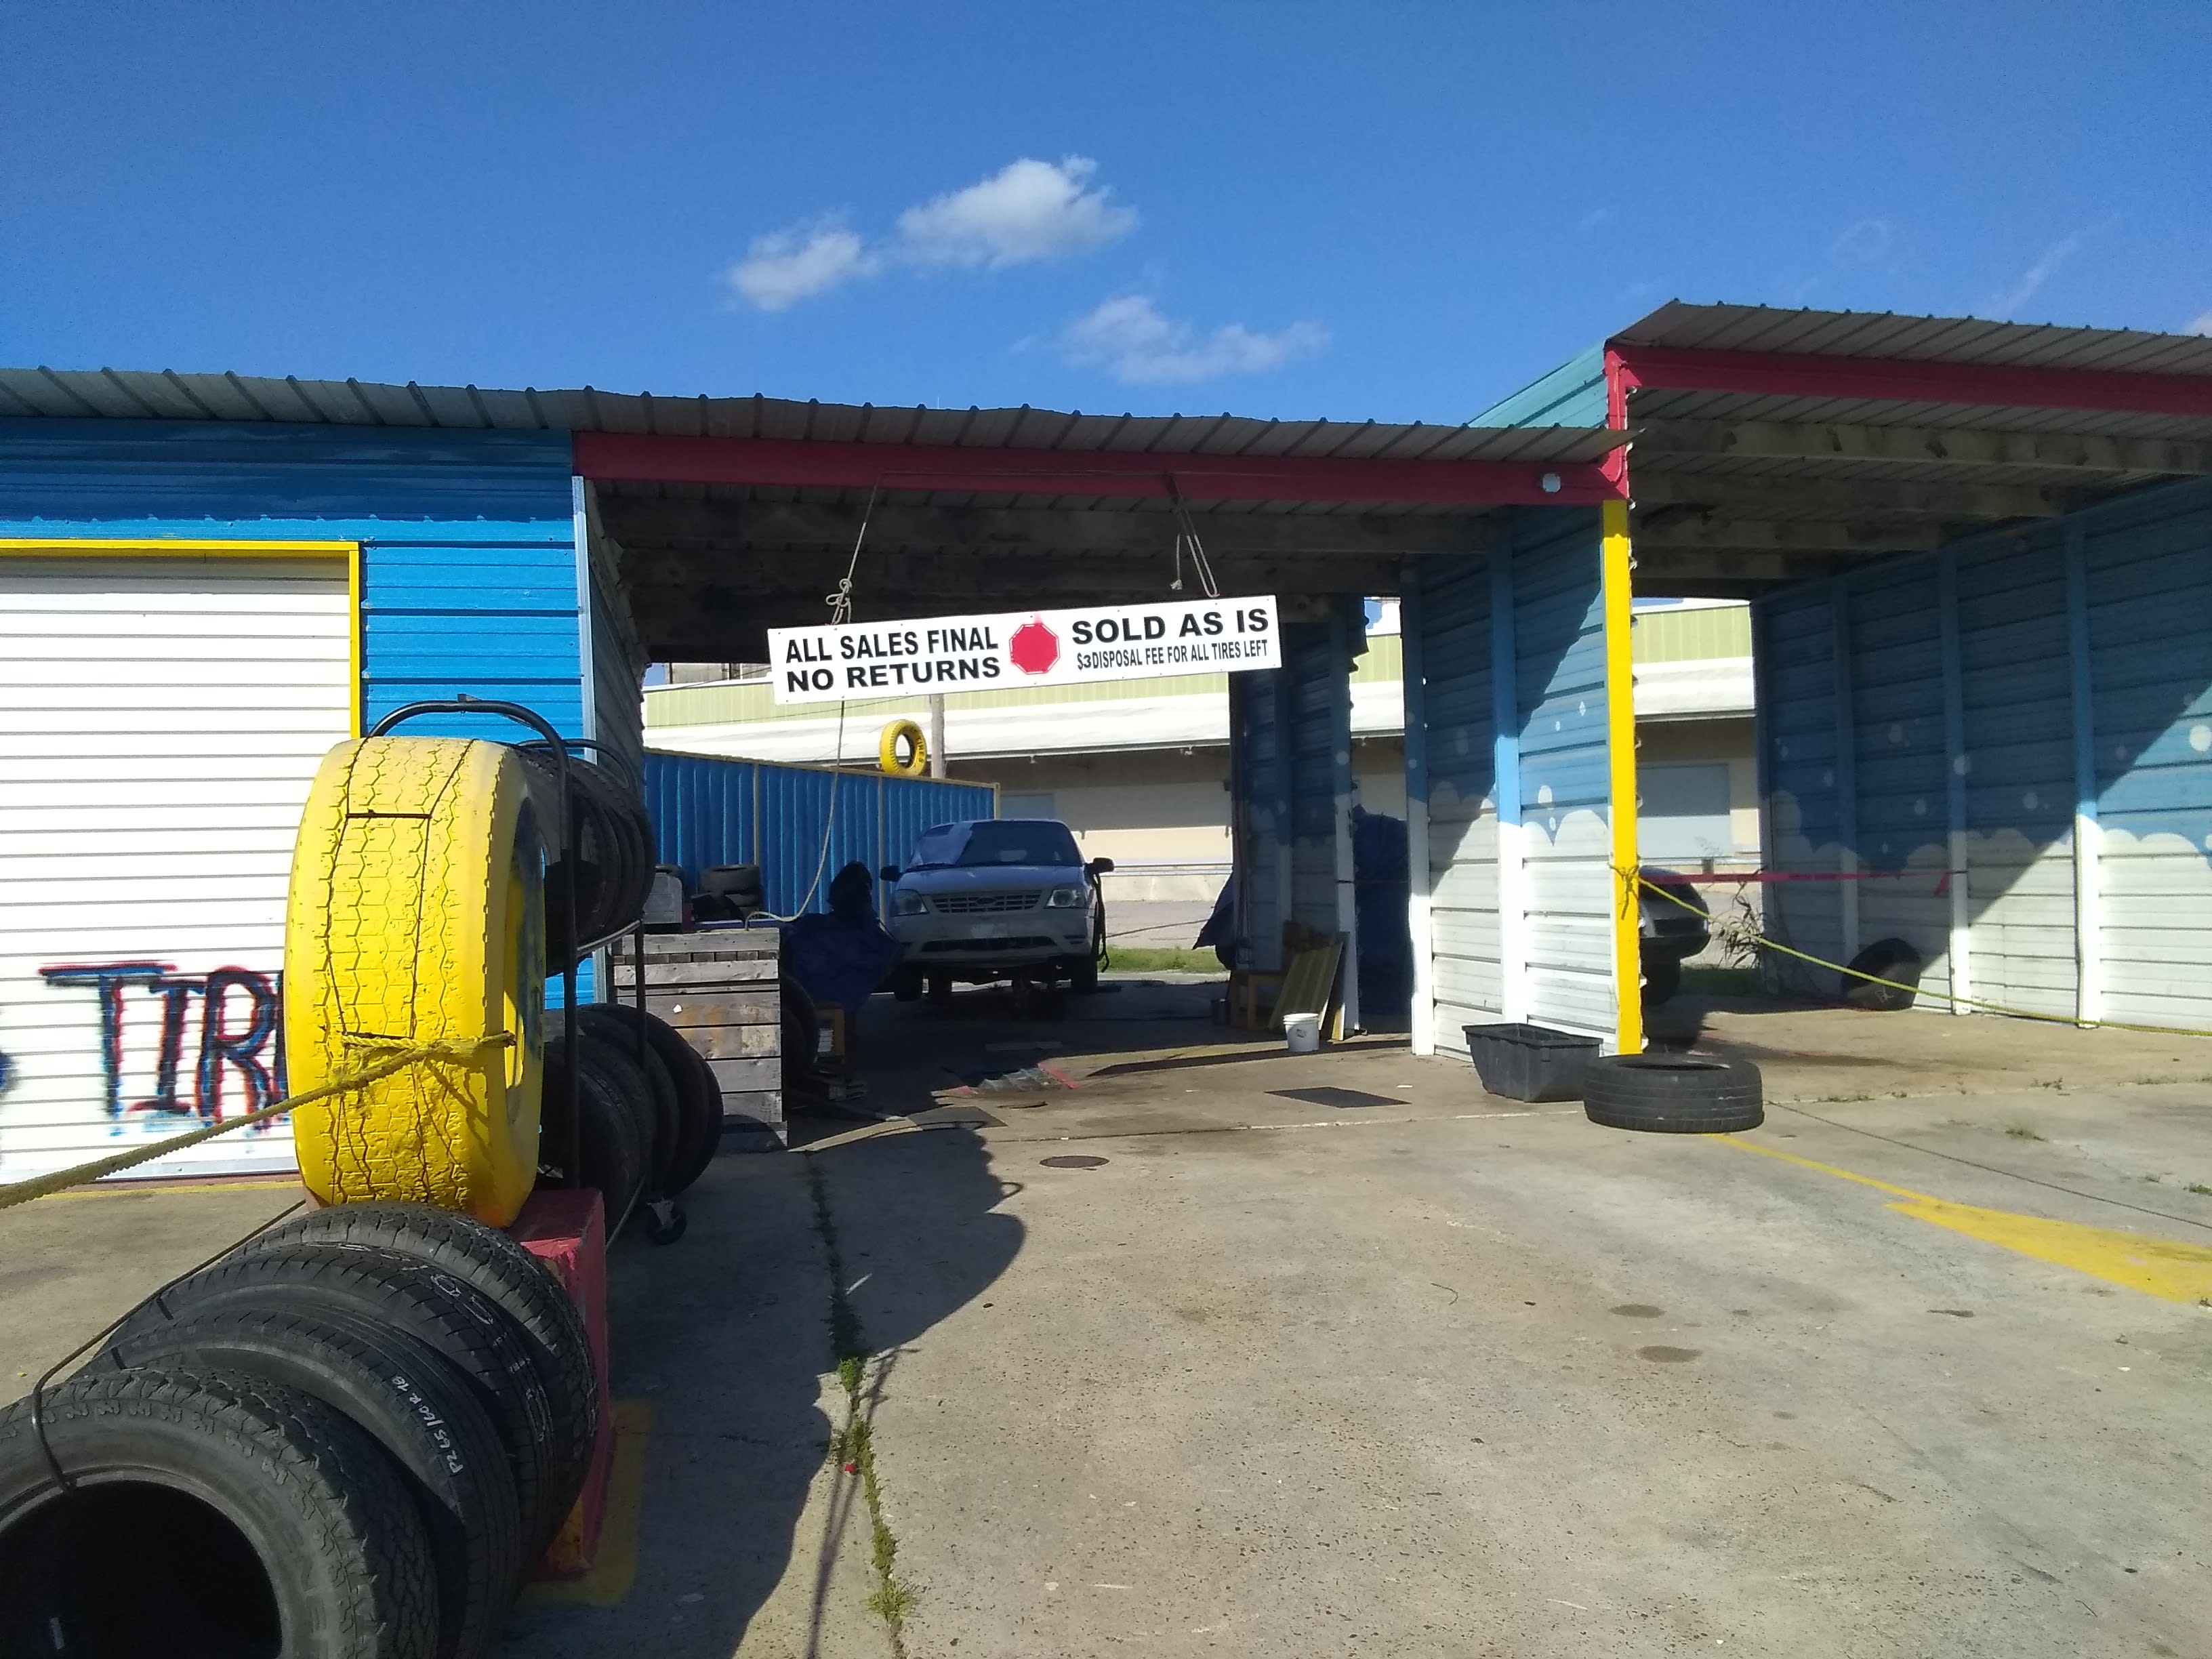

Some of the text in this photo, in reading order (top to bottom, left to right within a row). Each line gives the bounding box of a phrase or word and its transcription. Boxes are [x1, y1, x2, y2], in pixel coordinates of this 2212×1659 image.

[1071, 608, 1269, 644] SOLD AS IS
[785, 626, 999, 664] ALL SALES FINAL
[1145, 647, 1165, 665] FEE
[1167, 645, 1189, 663] FOR
[1191, 643, 1210, 662] ALL
[1211, 640, 1242, 660] TIRES
[1244, 639, 1268, 658] LEFT
[786, 657, 1001, 693] NO RETURNS
[38, 960, 291, 1126] TIR
